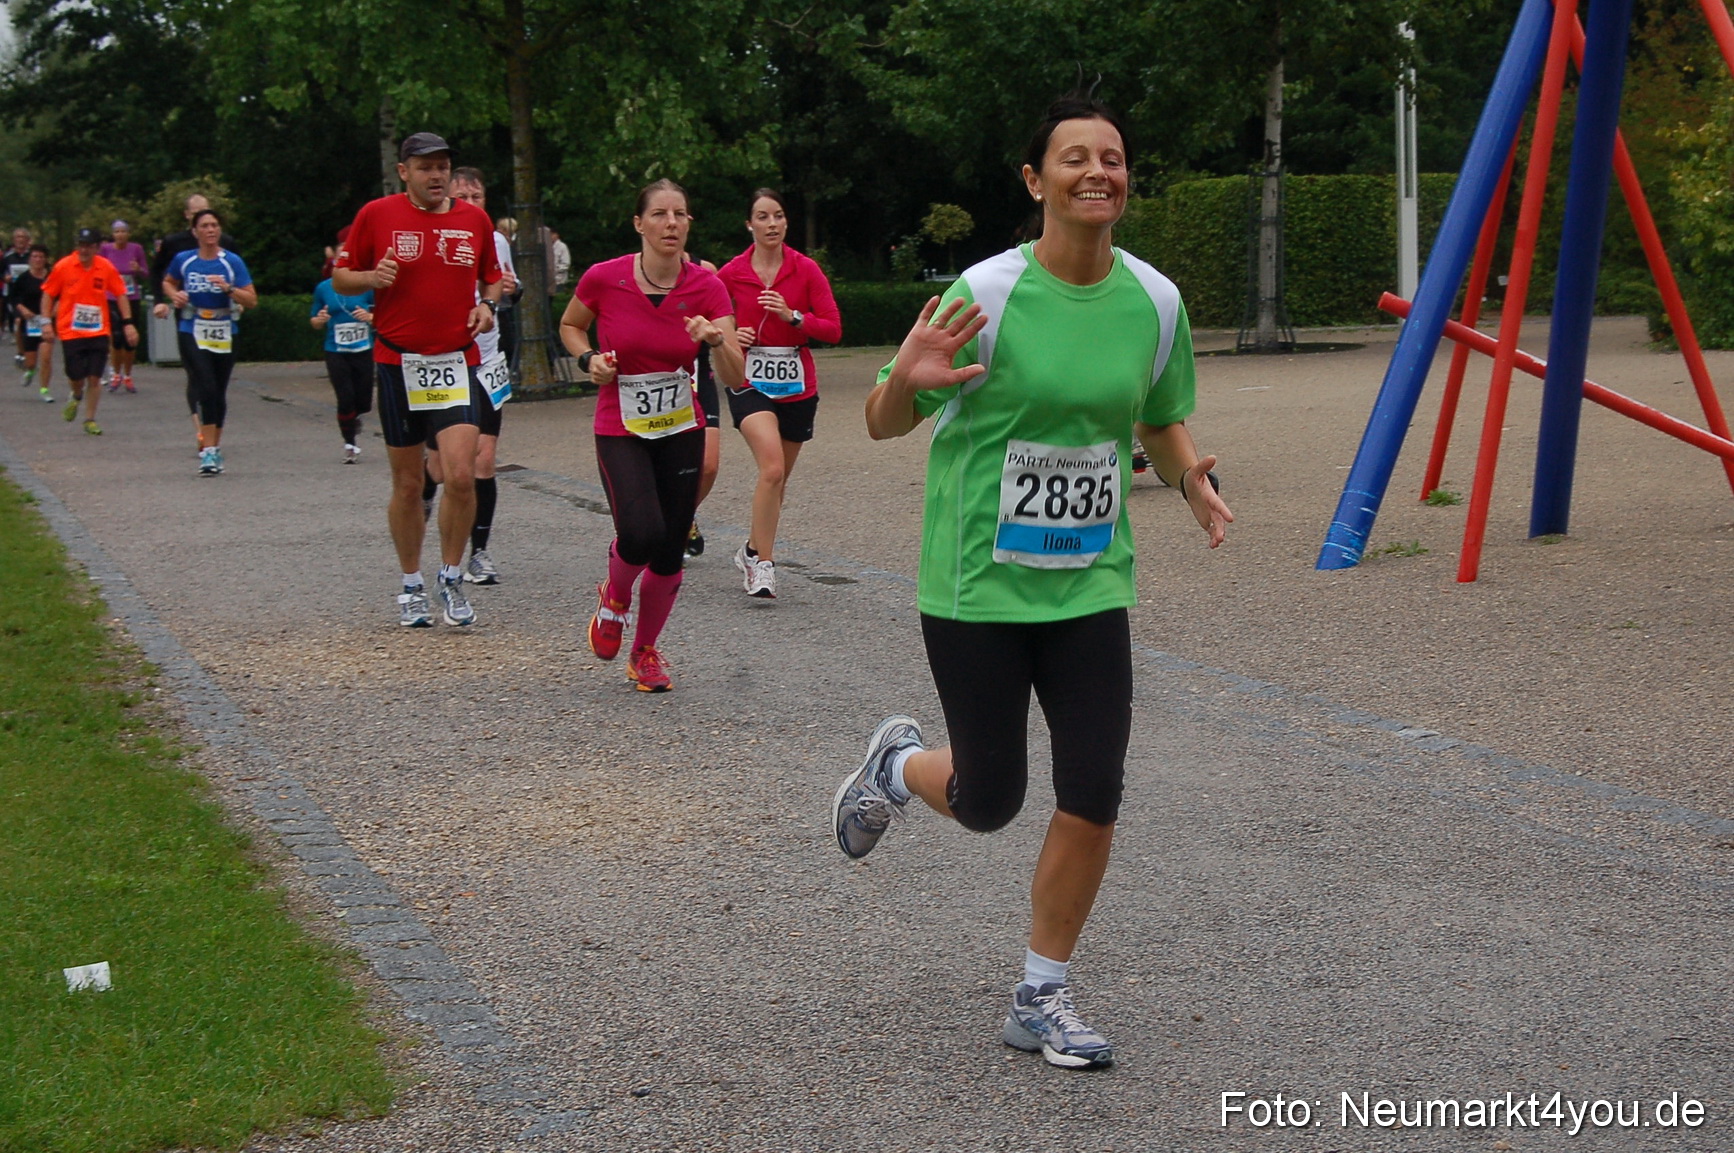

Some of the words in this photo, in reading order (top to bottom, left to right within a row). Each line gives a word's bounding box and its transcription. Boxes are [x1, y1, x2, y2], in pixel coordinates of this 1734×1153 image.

[416, 367, 455, 387] 326
[752, 359, 799, 380] 2663
[646, 376, 680, 386] Neumarkt
[426, 393, 449, 402] Stefan
[635, 384, 678, 415] 377
[648, 417, 674, 430] Anika
[1008, 453, 1052, 469] PARTL
[1056, 457, 1107, 470] Neumat
[1013, 472, 1113, 520] 2835
[1043, 533, 1081, 550] Ilona
